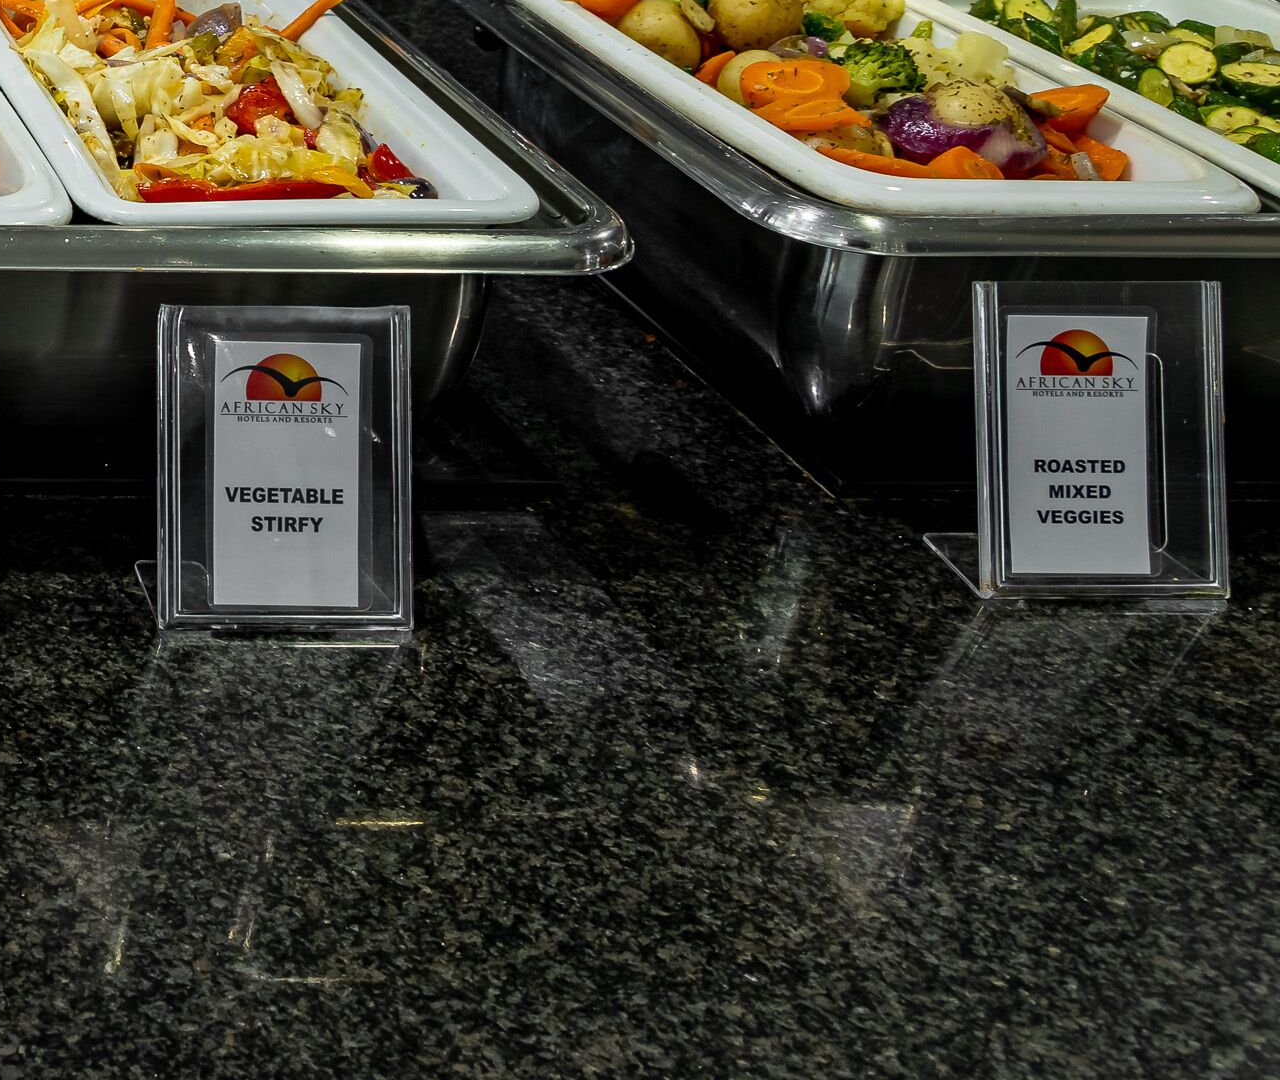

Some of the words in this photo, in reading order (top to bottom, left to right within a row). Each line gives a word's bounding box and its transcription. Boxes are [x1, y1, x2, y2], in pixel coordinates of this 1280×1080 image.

[1016, 376, 1096, 389] AFRICAN
[1102, 377, 1135, 389] SKY
[1066, 390, 1085, 398] AND
[221, 401, 304, 414] AFRICAN
[310, 403, 345, 415] SKY
[237, 415, 270, 423] HOTELS
[294, 416, 333, 424] RESORTS
[1034, 459, 1126, 474] ROASTED
[225, 487, 344, 505] VEGETABLE
[1048, 484, 1111, 499] MIXED
[251, 516, 324, 533] STIRFY
[1036, 510, 1124, 525] VEGGIES
